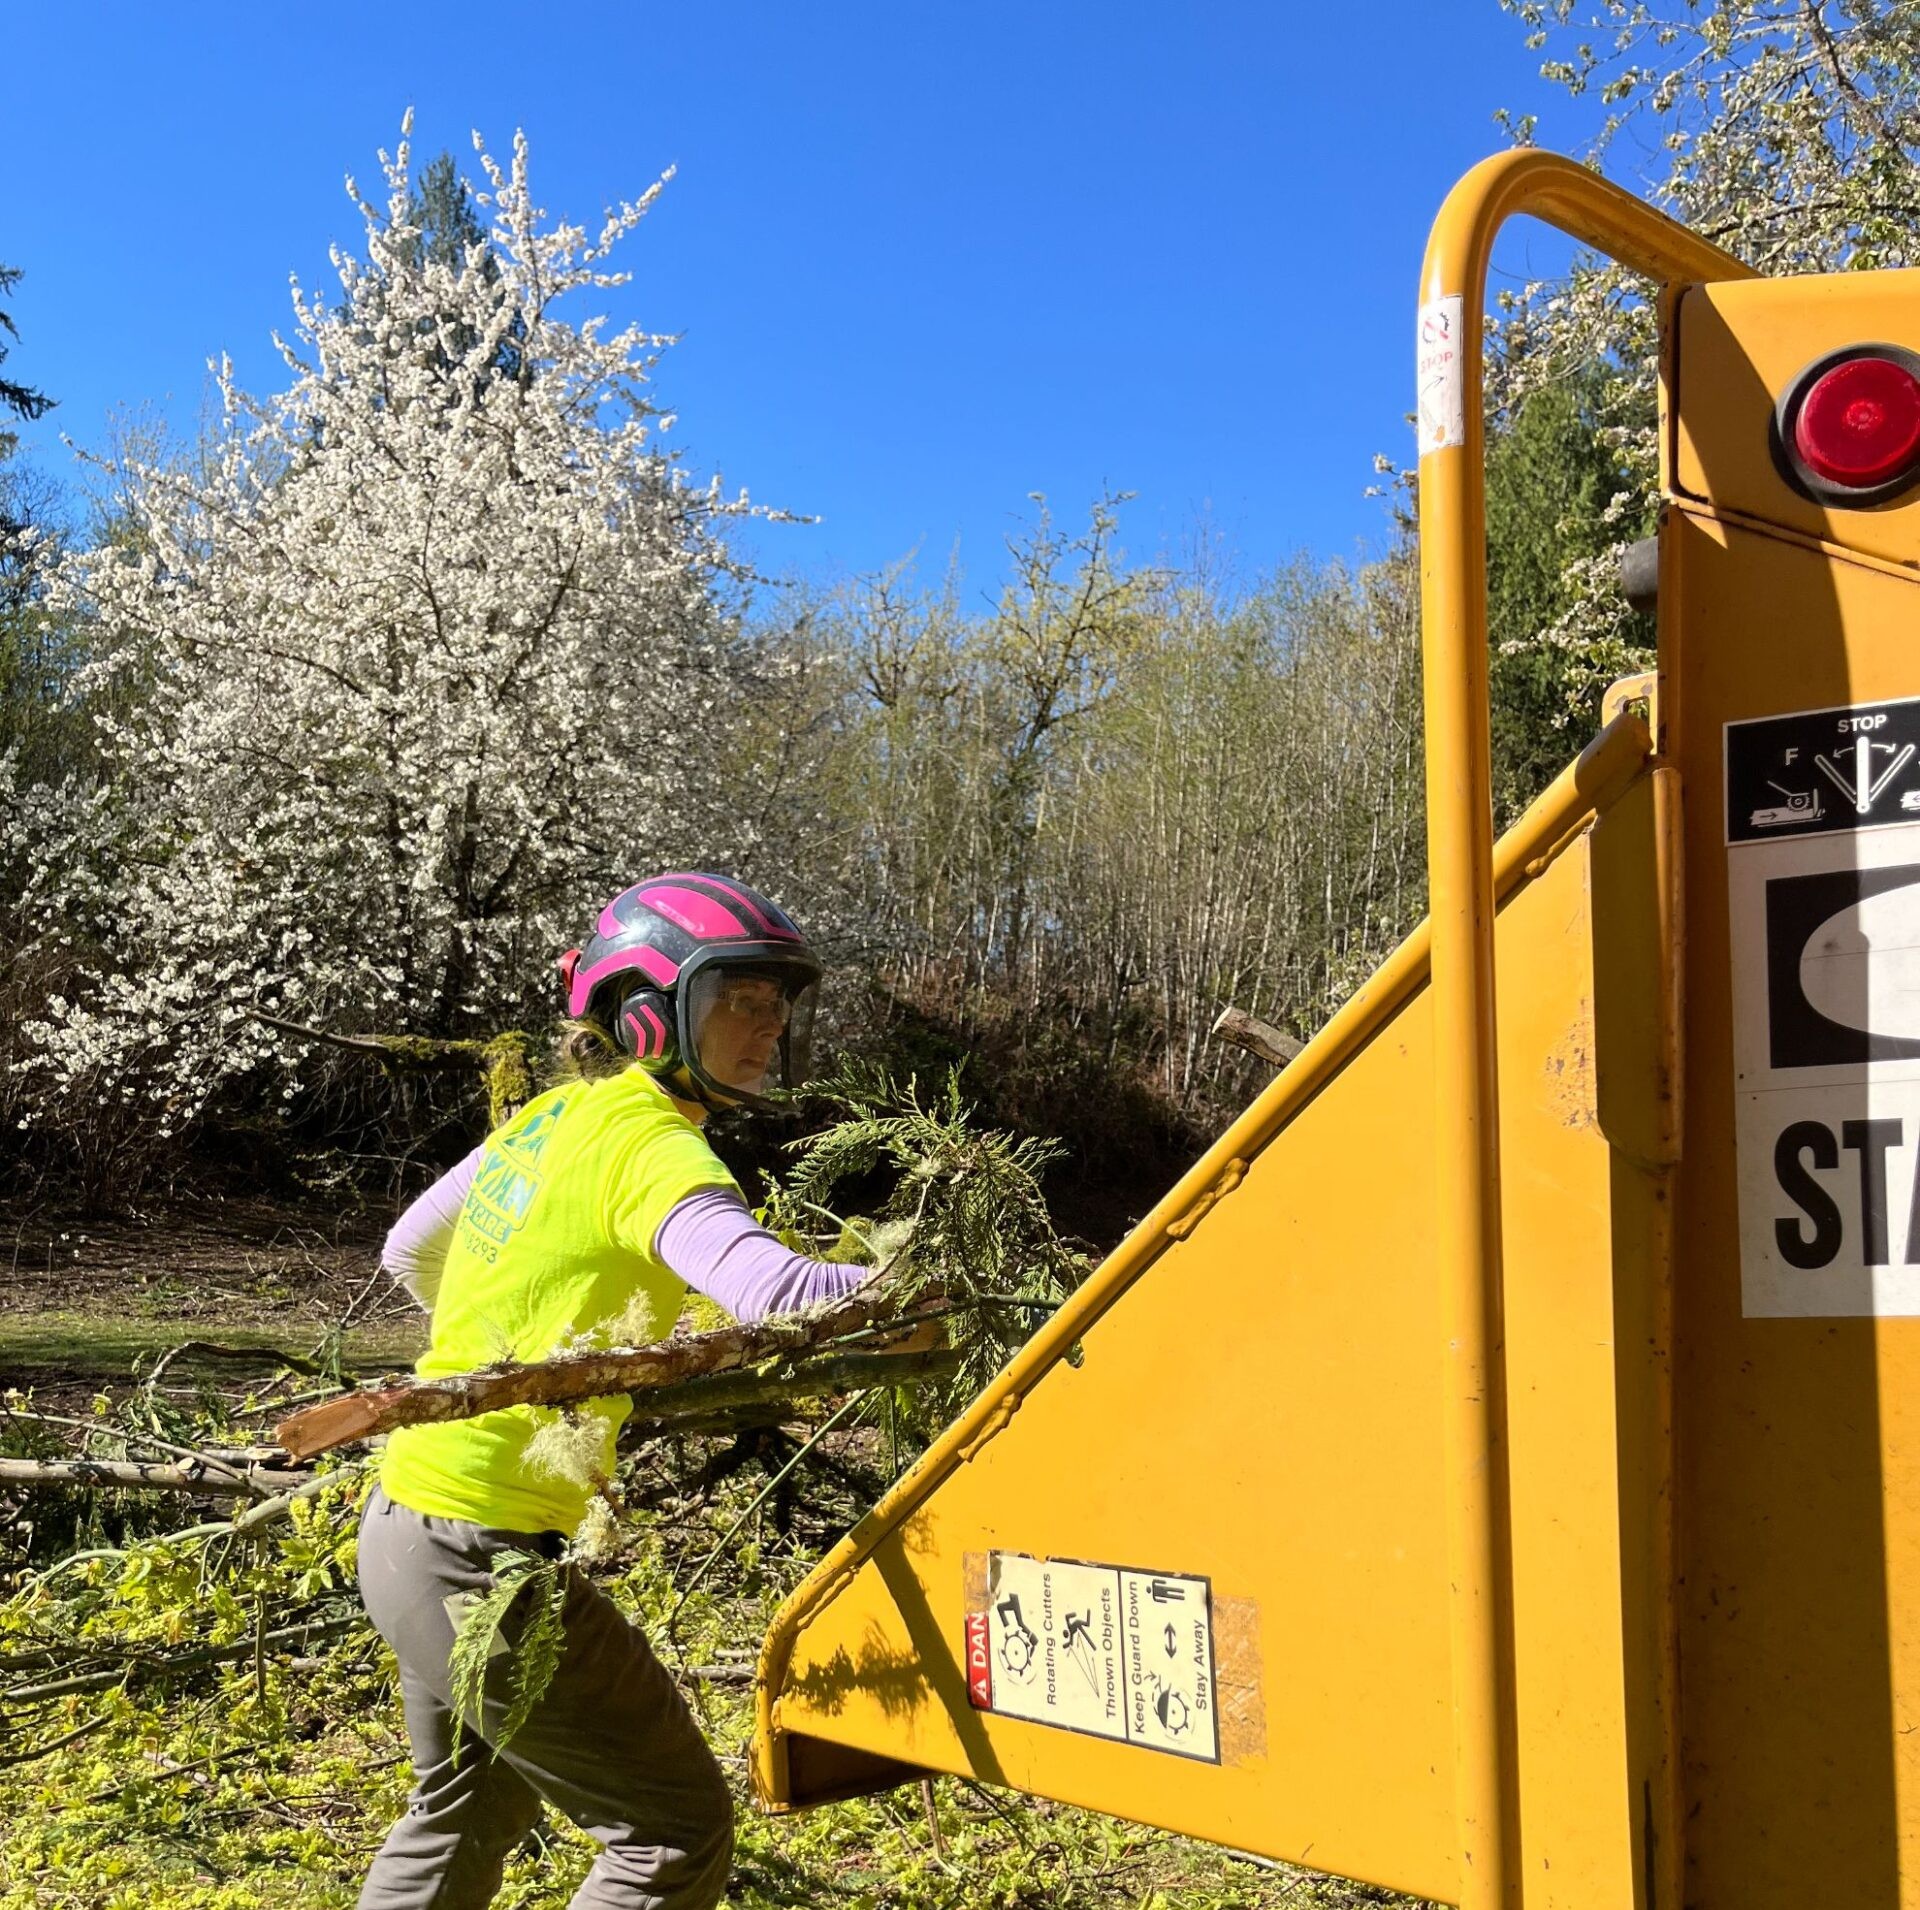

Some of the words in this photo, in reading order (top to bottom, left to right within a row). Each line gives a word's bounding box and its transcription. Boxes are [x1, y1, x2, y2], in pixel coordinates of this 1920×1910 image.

[1421, 351, 1453, 373] STOP
[1837, 714, 1888, 733] STOP
[1784, 747, 1799, 766] F
[1774, 1117, 1920, 1269] ST
[1042, 1573, 1053, 1632] Cutters
[1101, 1587, 1114, 1651] Objects
[1129, 1581, 1140, 1629] Down
[1130, 1634, 1142, 1686] Guard
[1193, 1619, 1206, 1668] Away
[1046, 1637, 1057, 1706] Rotating
[1104, 1657, 1116, 1719] Thrown
[1195, 1672, 1209, 1711] Stay
[1134, 1691, 1146, 1734] Keep
